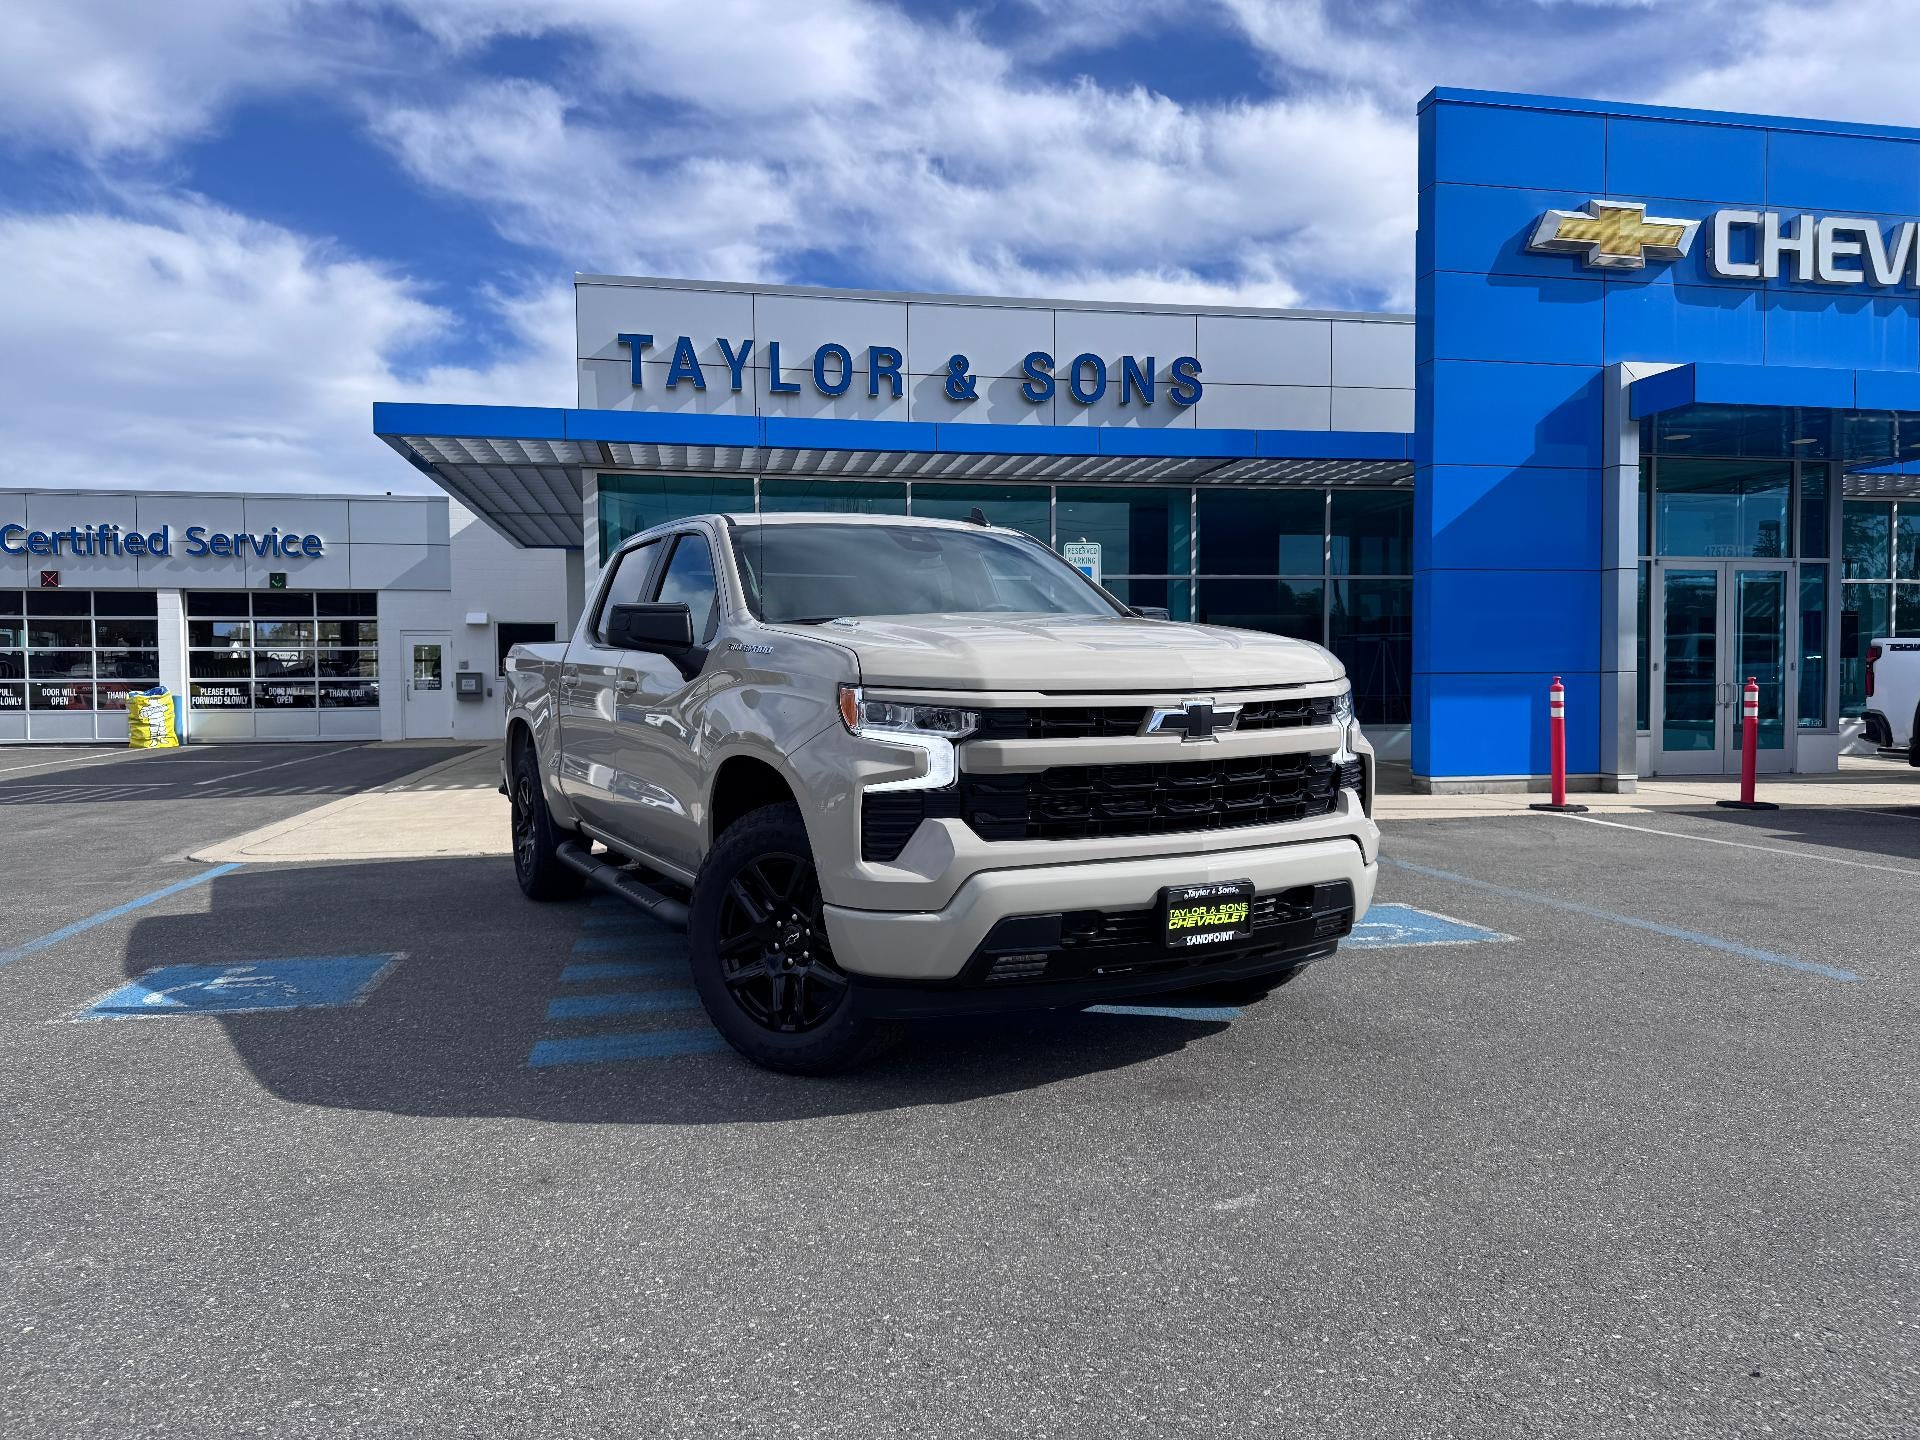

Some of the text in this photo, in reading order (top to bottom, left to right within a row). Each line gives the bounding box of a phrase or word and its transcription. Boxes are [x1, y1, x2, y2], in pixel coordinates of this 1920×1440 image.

[1714, 210, 1920, 286] CHEV
[617, 332, 1204, 406] TAYLOR & SONS
[0, 523, 324, 558] Certified Service
[1067, 547, 1097, 555] RESERVED
[42, 688, 60, 697] DOOR
[61, 688, 78, 697] WILL
[200, 687, 241, 696] PLEASE PULL
[268, 687, 286, 696] DOOR
[329, 689, 365, 698] THANK YOU!
[51, 697, 69, 706] OPEN
[192, 695, 249, 705] FORWARD SLOWLY
[276, 695, 294, 704] OPEN
[1188, 888, 1210, 899] Taylor
[1218, 886, 1236, 895] Sons
[1170, 902, 1249, 918] TAYLOR & SONS
[1168, 911, 1249, 930] CHEVROLET
[1186, 931, 1235, 945] SANDPOINT
